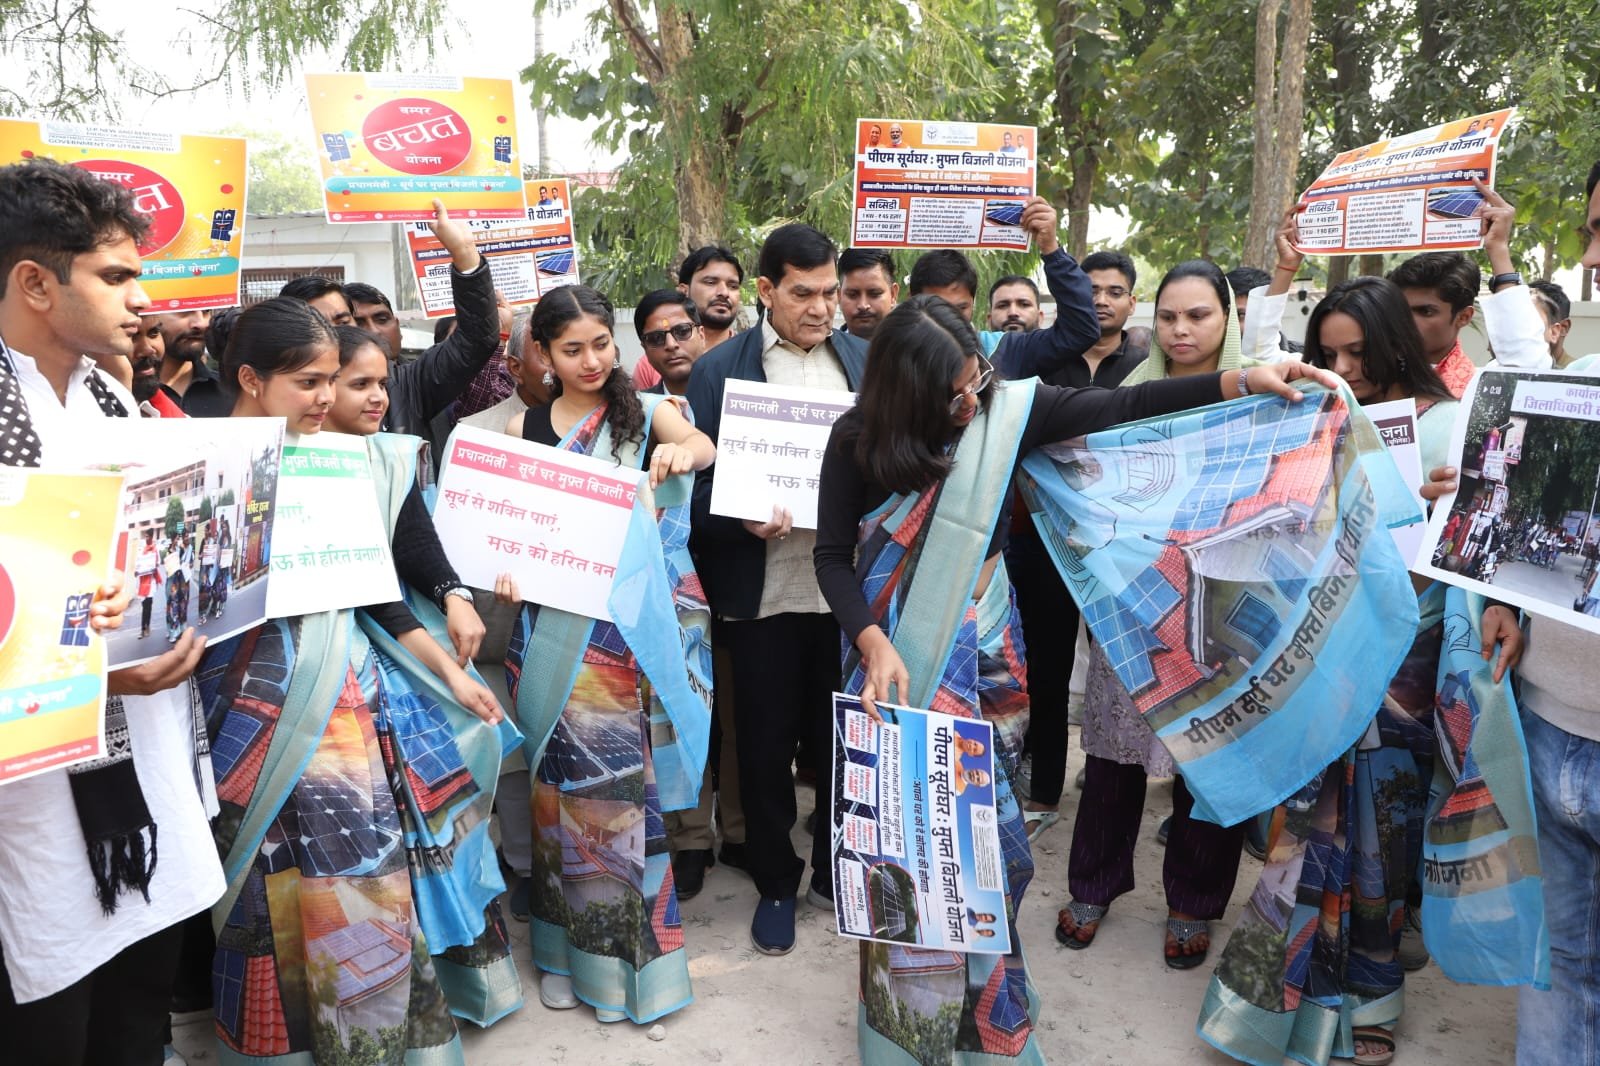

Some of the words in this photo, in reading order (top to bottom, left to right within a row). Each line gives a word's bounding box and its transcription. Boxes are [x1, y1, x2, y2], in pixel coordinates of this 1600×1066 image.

[364, 115, 463, 153] बचत
[404, 153, 442, 165] योजना
[868, 149, 895, 163] पीएम
[897, 150, 928, 168] सूर्यघर
[936, 154, 960, 169] मुफ्त
[961, 152, 995, 166] बिजली
[996, 153, 1026, 167] योजना
[1385, 151, 1411, 166] मुफ्त
[1411, 141, 1449, 158] बिजली
[1450, 137, 1487, 151] योजना
[536, 206, 563, 220] योजना
[868, 199, 897, 209] सब्सिडी
[1308, 200, 1335, 213] सब्सिडी
[153, 264, 184, 275] बिजली
[1523, 396, 1592, 416] जिलाधिकारी
[1566, 387, 1600, 400] कार्याल
[730, 398, 779, 415] प्रधानमंत्री
[790, 404, 808, 420] सूर्य
[810, 409, 825, 420] घर
[310, 451, 341, 470] बिजली
[722, 436, 748, 455] सूर्य
[750, 438, 768, 454] की
[772, 441, 810, 459] शक्ति
[457, 446, 509, 471] प्रधानमंत्री
[518, 459, 537, 478] सूर्य
[541, 470, 556, 482] घर
[558, 473, 585, 491] मुफ्त
[587, 476, 626, 499] बिजली
[767, 473, 801, 489] मऊ
[444, 488, 472, 510] सूर्य
[472, 492, 486, 510] से
[488, 499, 528, 521] शक्ति
[269, 554, 293, 572] ऊ
[297, 544, 316, 568] को
[318, 543, 352, 568] हरित
[488, 534, 522, 556] मऊ
[527, 542, 548, 562] को
[551, 549, 589, 573] हरित
[1183, 703, 1243, 745] पीएम
[1234, 676, 1274, 715] सूर्य
[1260, 653, 1296, 688] घर
[1286, 609, 1324, 661] मुफ्त
[934, 726, 953, 772] पीएम
[928, 770, 952, 817] सूर्यघर
[931, 822, 954, 860] मुफ्त
[940, 860, 960, 905] बिजली
[947, 905, 966, 944] योजना
